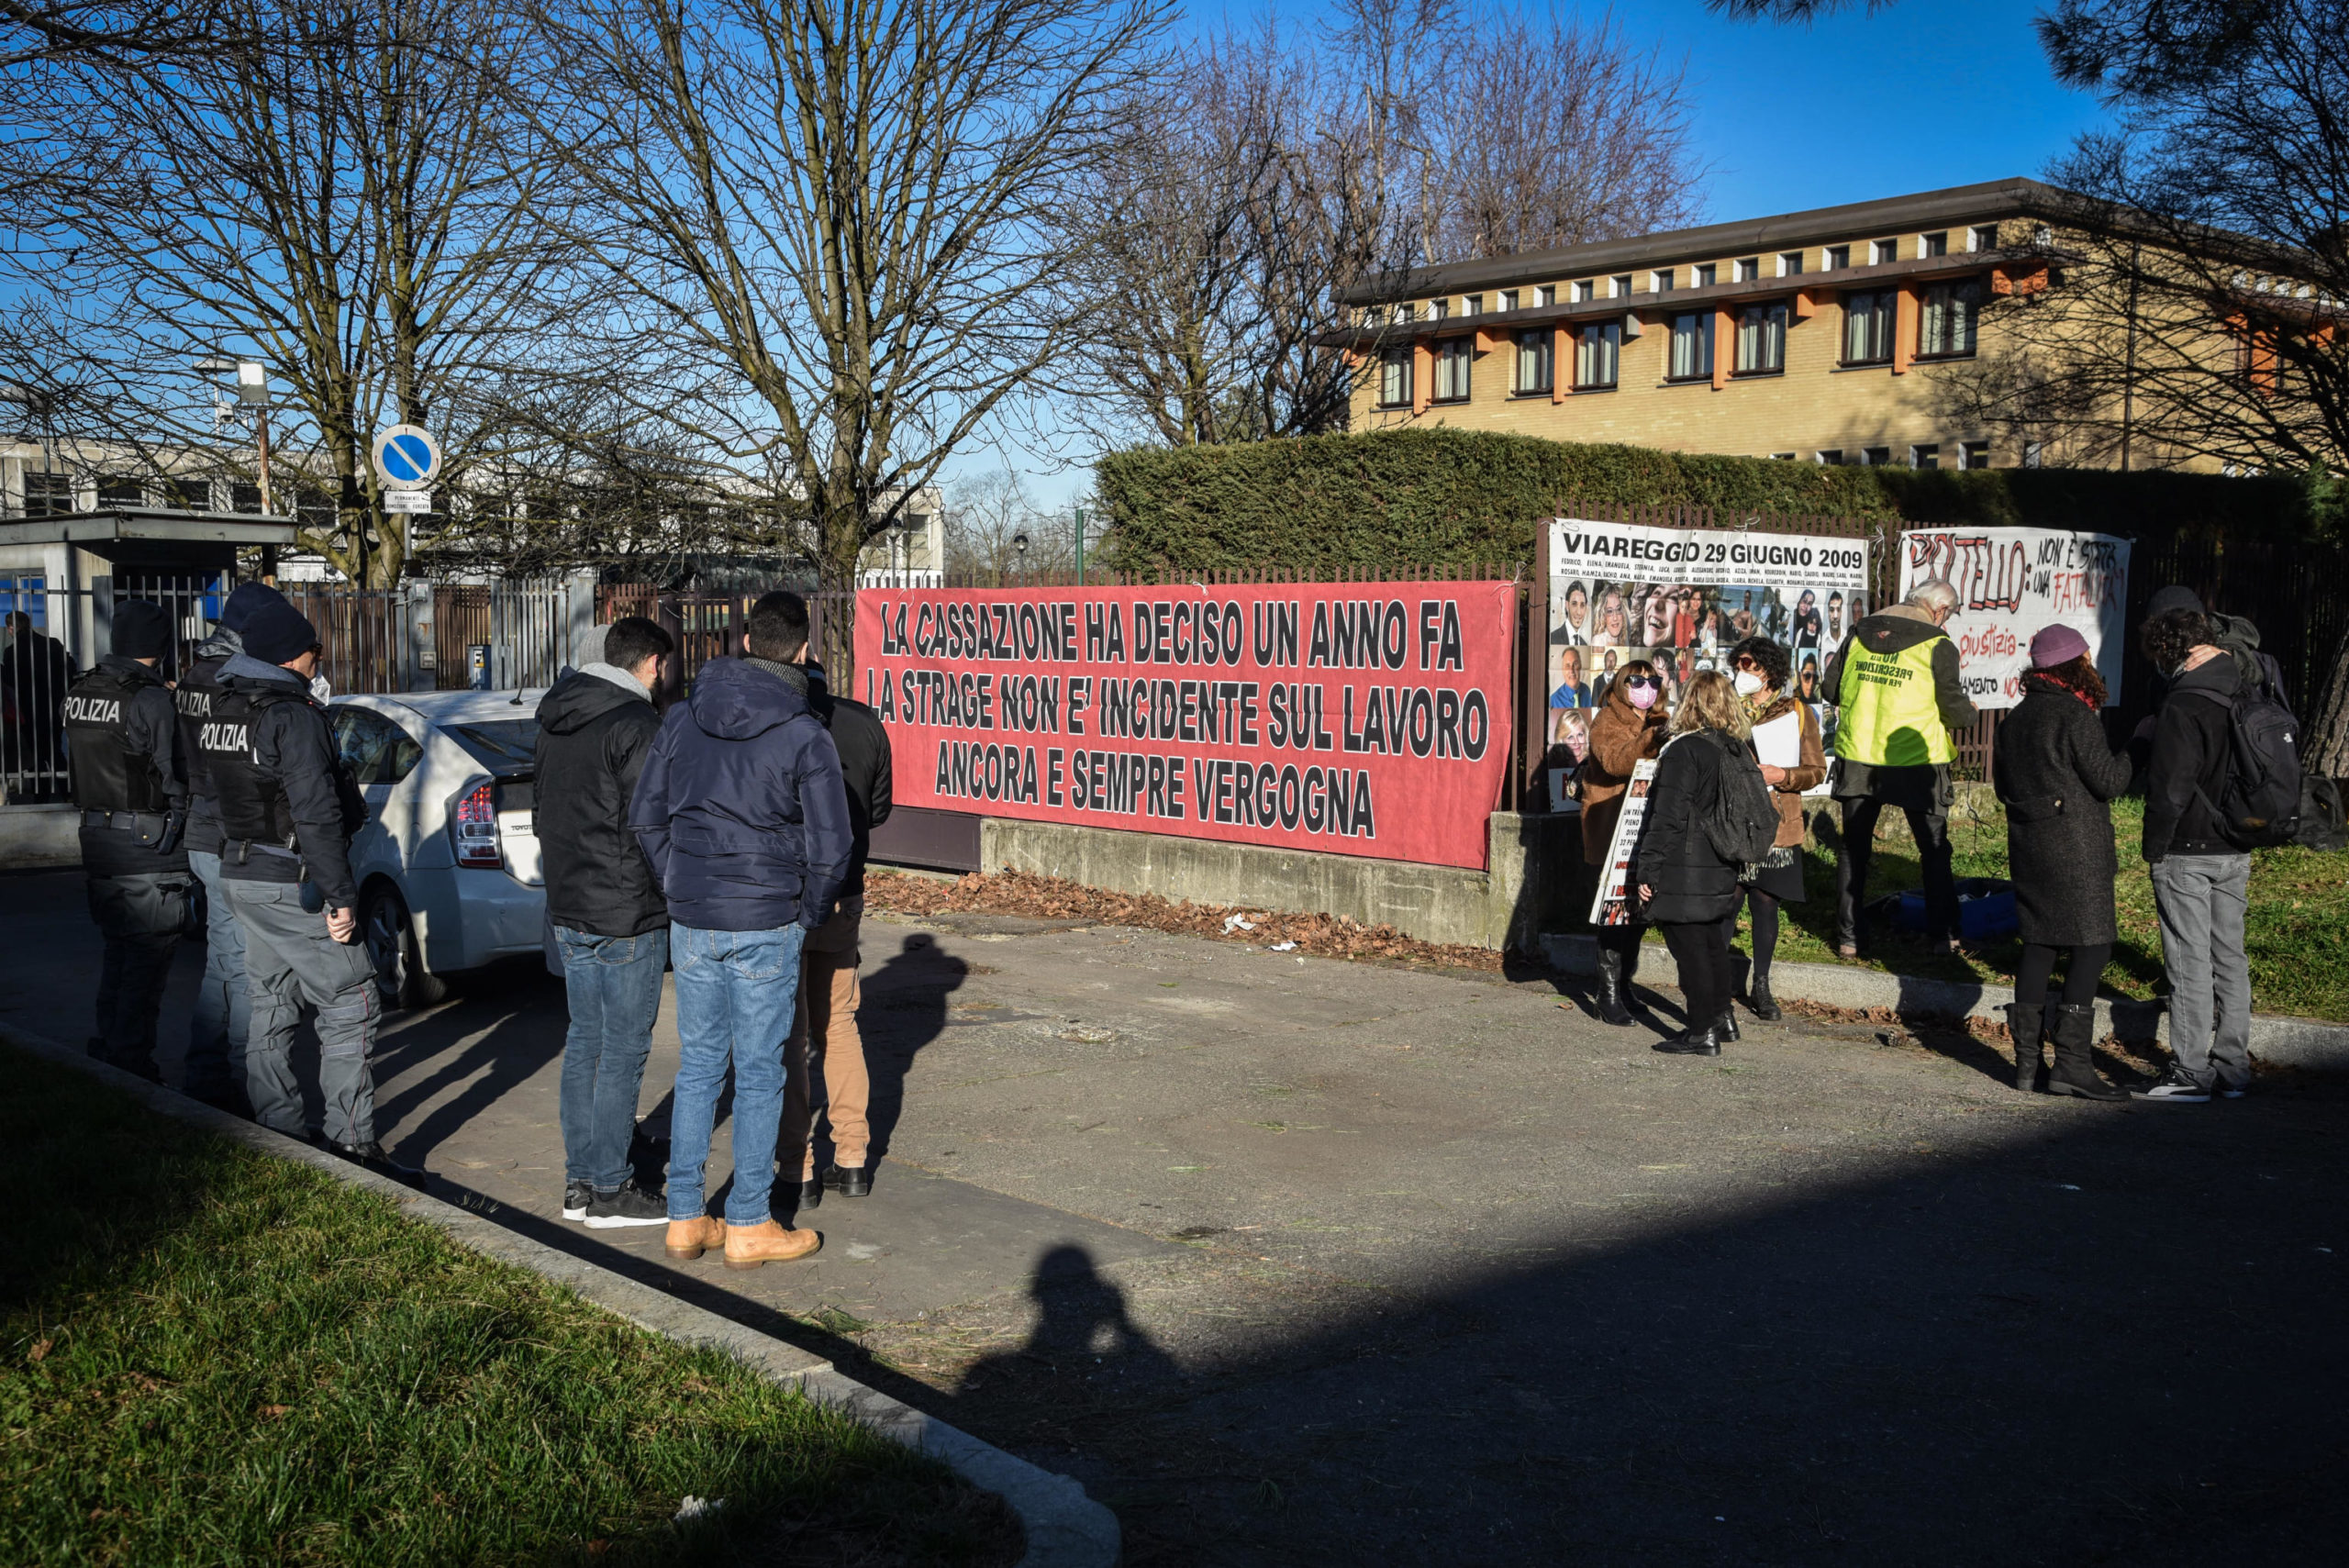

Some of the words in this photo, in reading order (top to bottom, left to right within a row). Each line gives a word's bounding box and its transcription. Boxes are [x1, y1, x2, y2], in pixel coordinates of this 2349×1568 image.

[1563, 533, 1700, 562] VIAREGGIO
[1705, 543, 1726, 563] 29
[1731, 544, 1812, 566] GIUGNO
[1819, 550, 1863, 569] 2009
[2037, 537, 2065, 568] NON
[2033, 569, 2051, 599] UNA
[880, 601, 912, 657] LA
[914, 601, 1079, 662] CASSAZIONE
[1085, 601, 1124, 663] HA
[1133, 599, 1243, 668] DECISO
[1252, 600, 1299, 669] UN
[1308, 598, 1408, 672] ANNO
[1419, 599, 1464, 672] FA
[1959, 622, 2017, 670] giustizia
[1960, 675, 1998, 695] AMENTO
[63, 696, 120, 724] POLIZIA
[175, 689, 212, 717] POLIZIA
[867, 668, 896, 723] LA
[901, 668, 994, 729] STRAGE
[999, 674, 1060, 734] NON
[1099, 677, 1260, 747] INCIDENTE
[1267, 684, 1333, 751] SUL
[1342, 685, 1490, 762] LAVORO
[200, 723, 249, 752] POLIZIA
[934, 740, 1040, 806] ANCORA
[1047, 749, 1064, 808] E
[1071, 750, 1186, 819] SEMPRE
[1193, 758, 1376, 840] VERGOGNA
